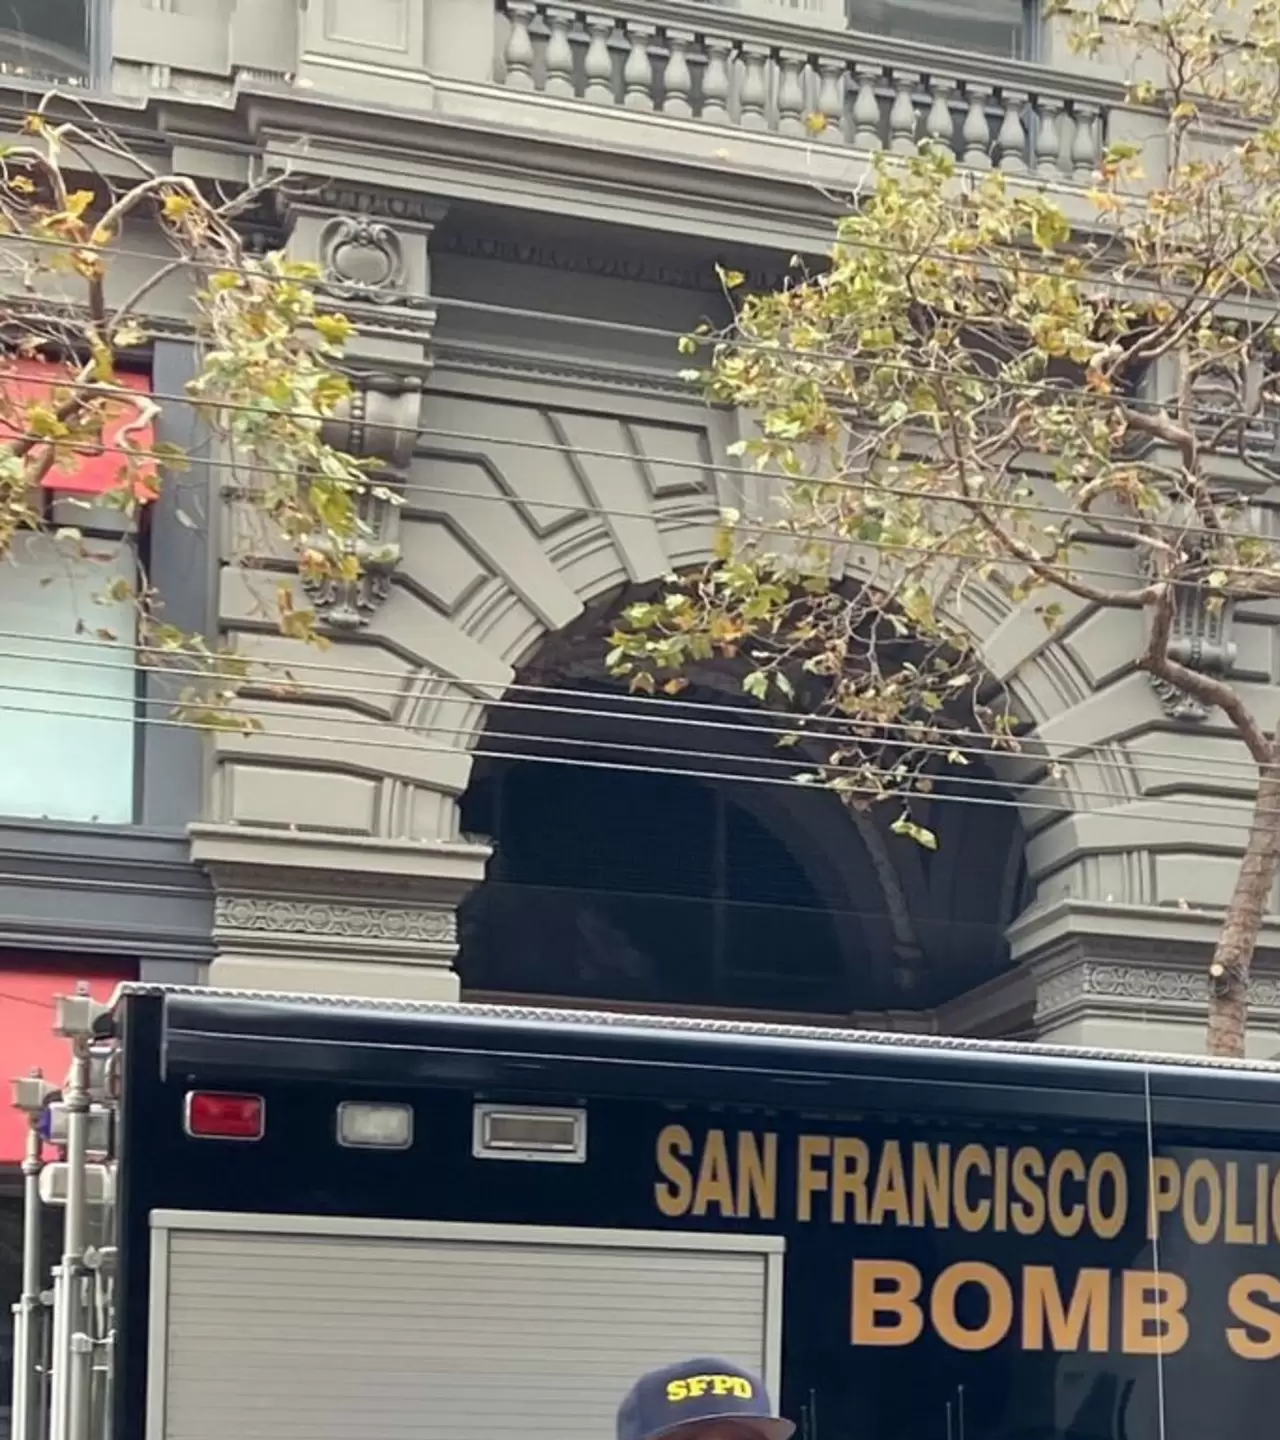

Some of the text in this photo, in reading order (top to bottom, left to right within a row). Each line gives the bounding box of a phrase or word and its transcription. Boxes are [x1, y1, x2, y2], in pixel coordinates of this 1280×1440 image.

[654, 1125, 778, 1219] SAN
[797, 1135, 1126, 1239] FRANCISCO
[850, 1259, 1190, 1356] BOMB
[666, 1375, 752, 1401] SFPD
